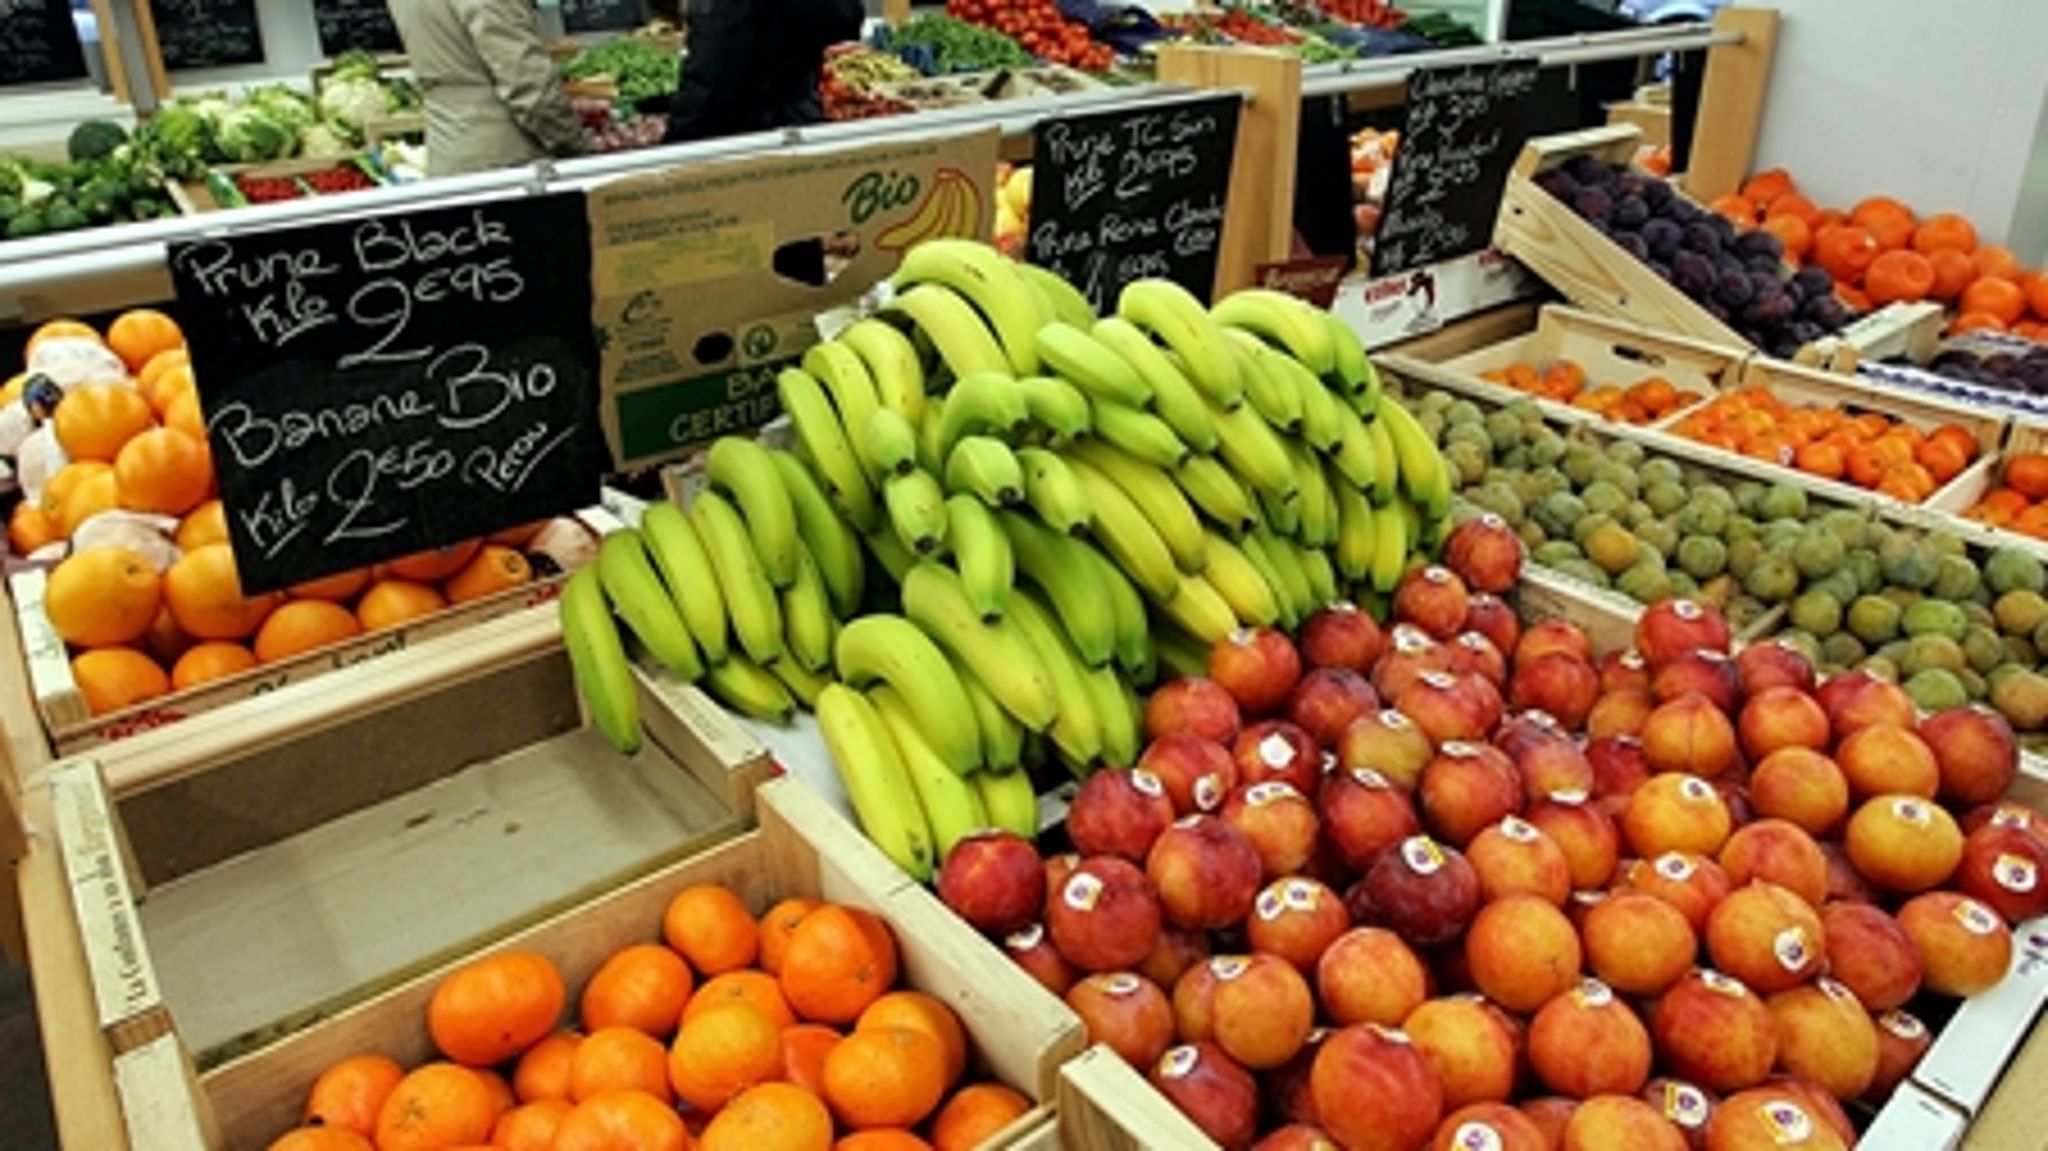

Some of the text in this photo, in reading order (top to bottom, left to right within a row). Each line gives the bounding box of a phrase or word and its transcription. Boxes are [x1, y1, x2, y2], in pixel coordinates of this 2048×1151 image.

[842, 169, 921, 225] Bio
[176, 211, 511, 295] Prune Black
[243, 279, 338, 345] Kilo
[208, 390, 435, 467] Banane
[240, 478, 319, 557] Kilo
